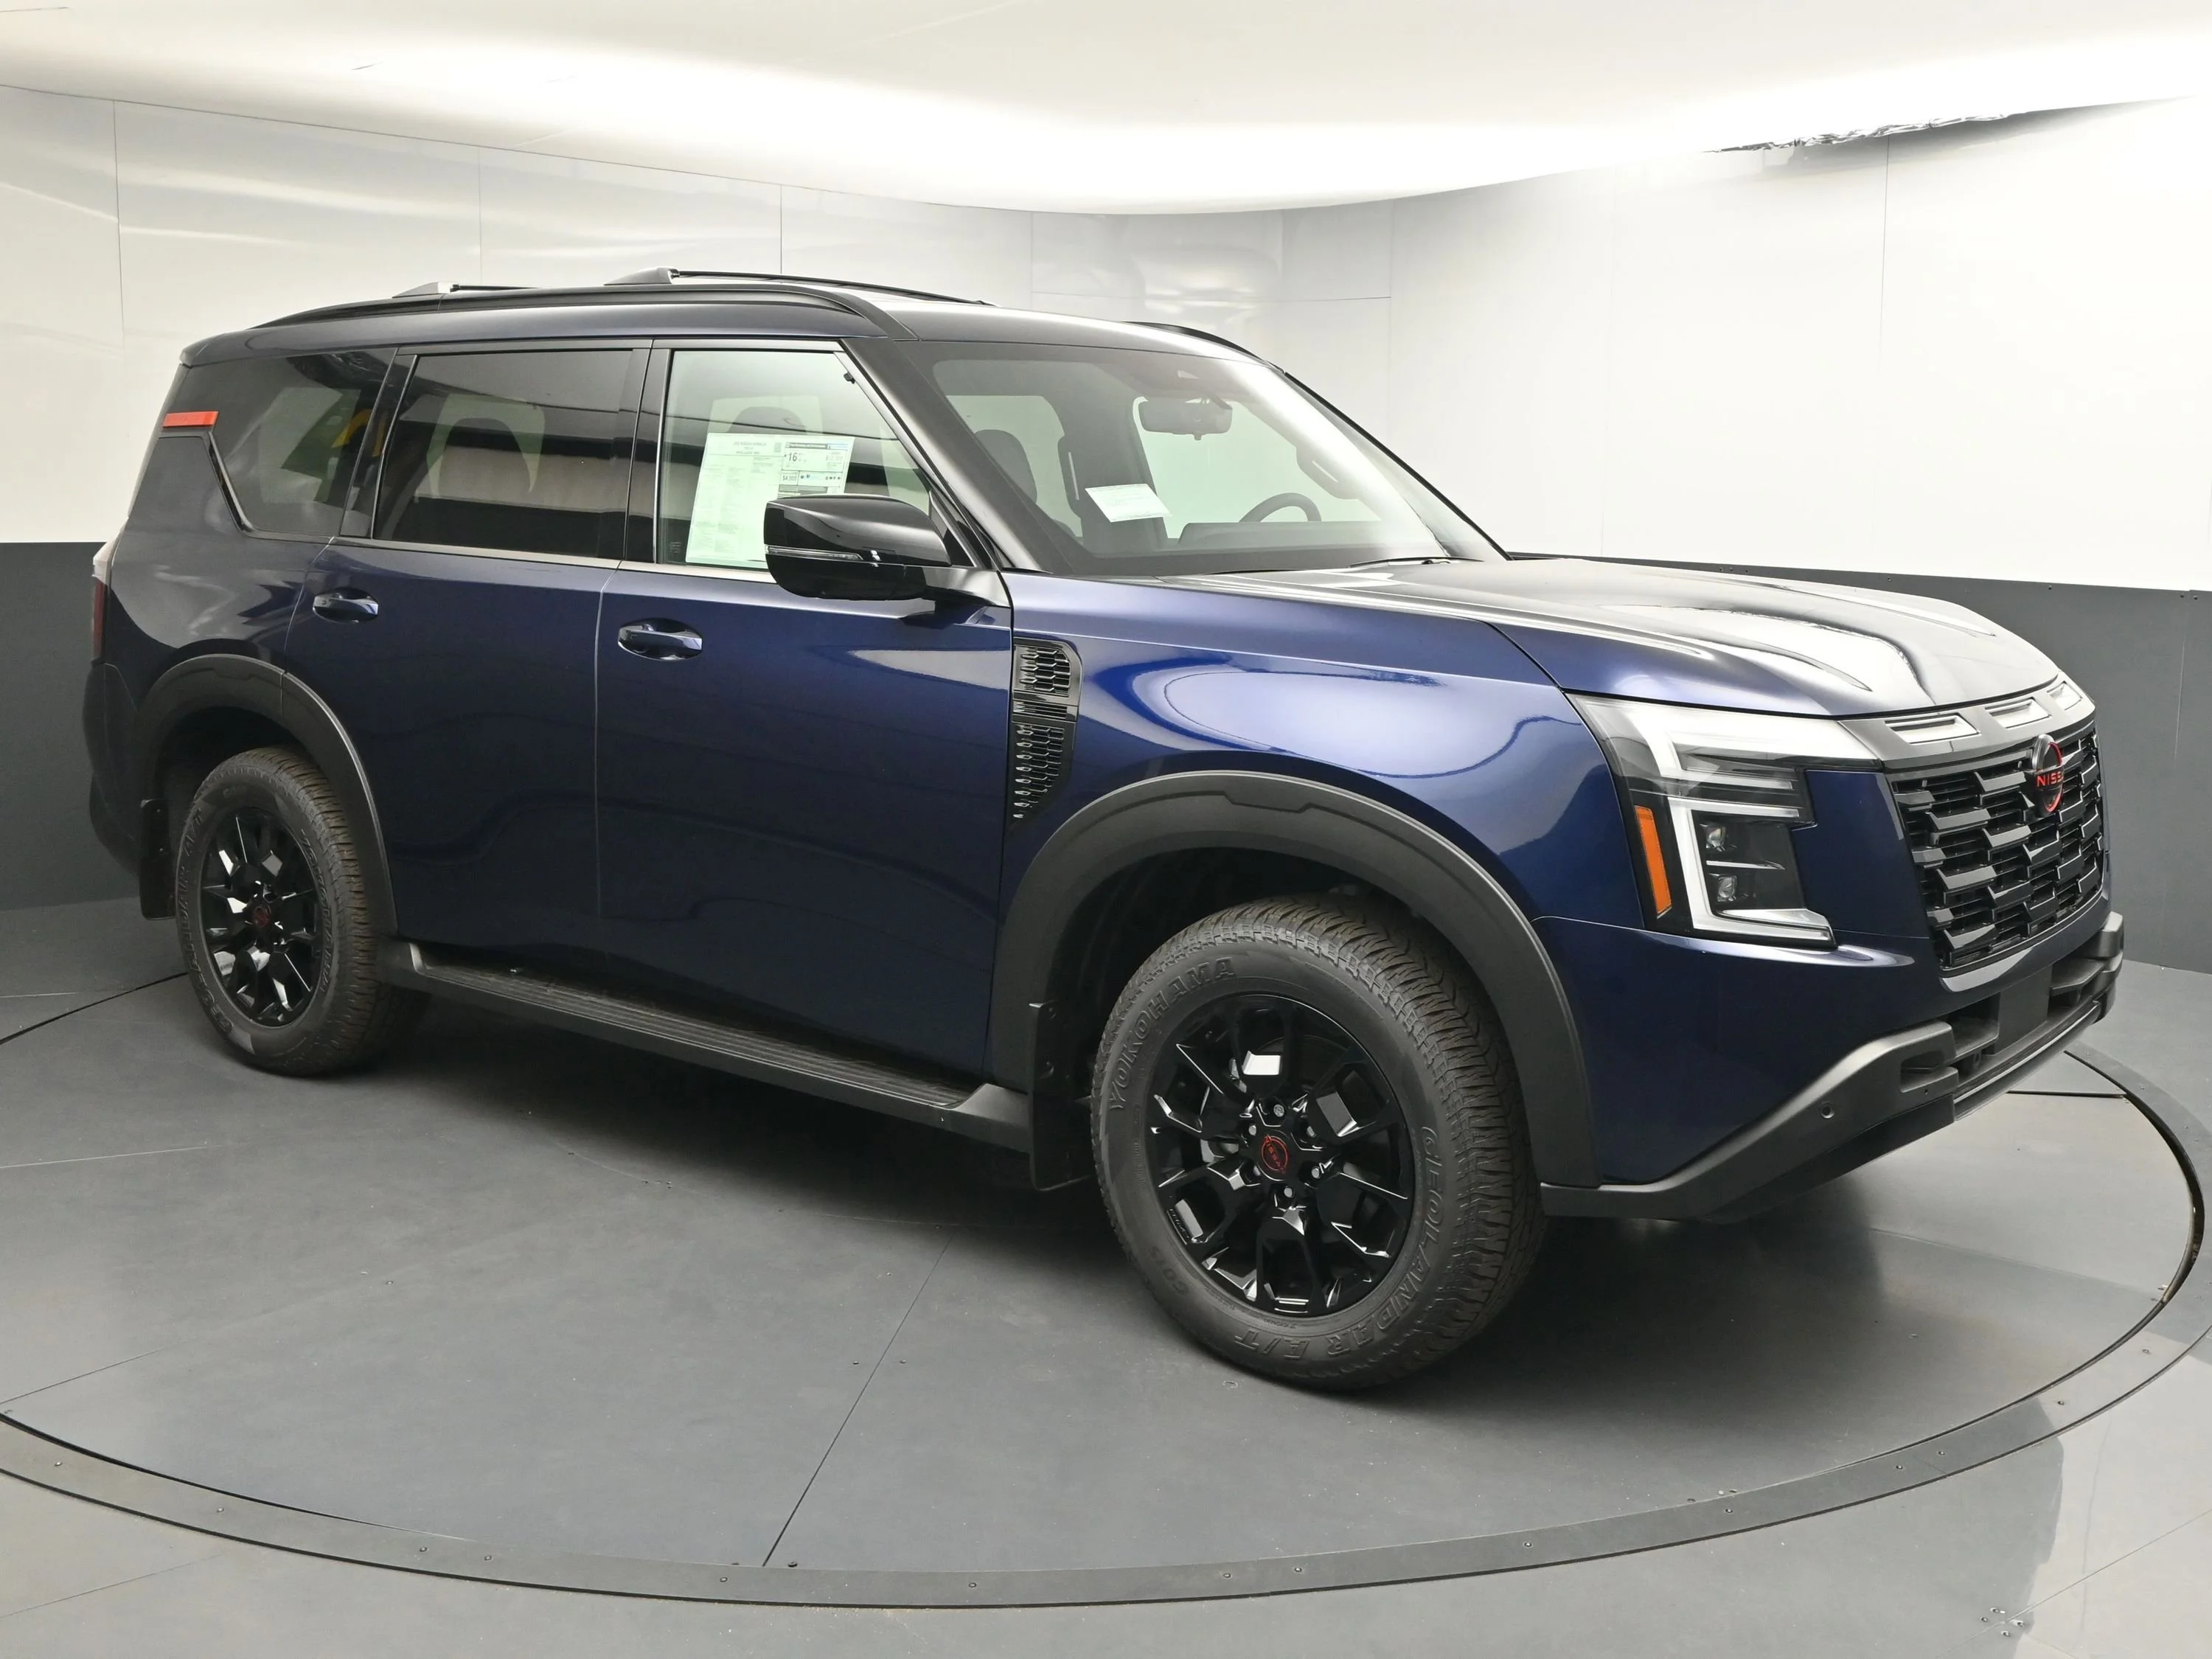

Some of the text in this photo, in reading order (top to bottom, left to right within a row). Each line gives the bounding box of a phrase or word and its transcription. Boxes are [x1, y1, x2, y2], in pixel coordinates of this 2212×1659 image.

[2037, 771, 2064, 787] NISS
[1108, 956, 1235, 1110] YOKOHAMA
[1234, 1126, 1444, 1360] GEOLANDAR A/T
